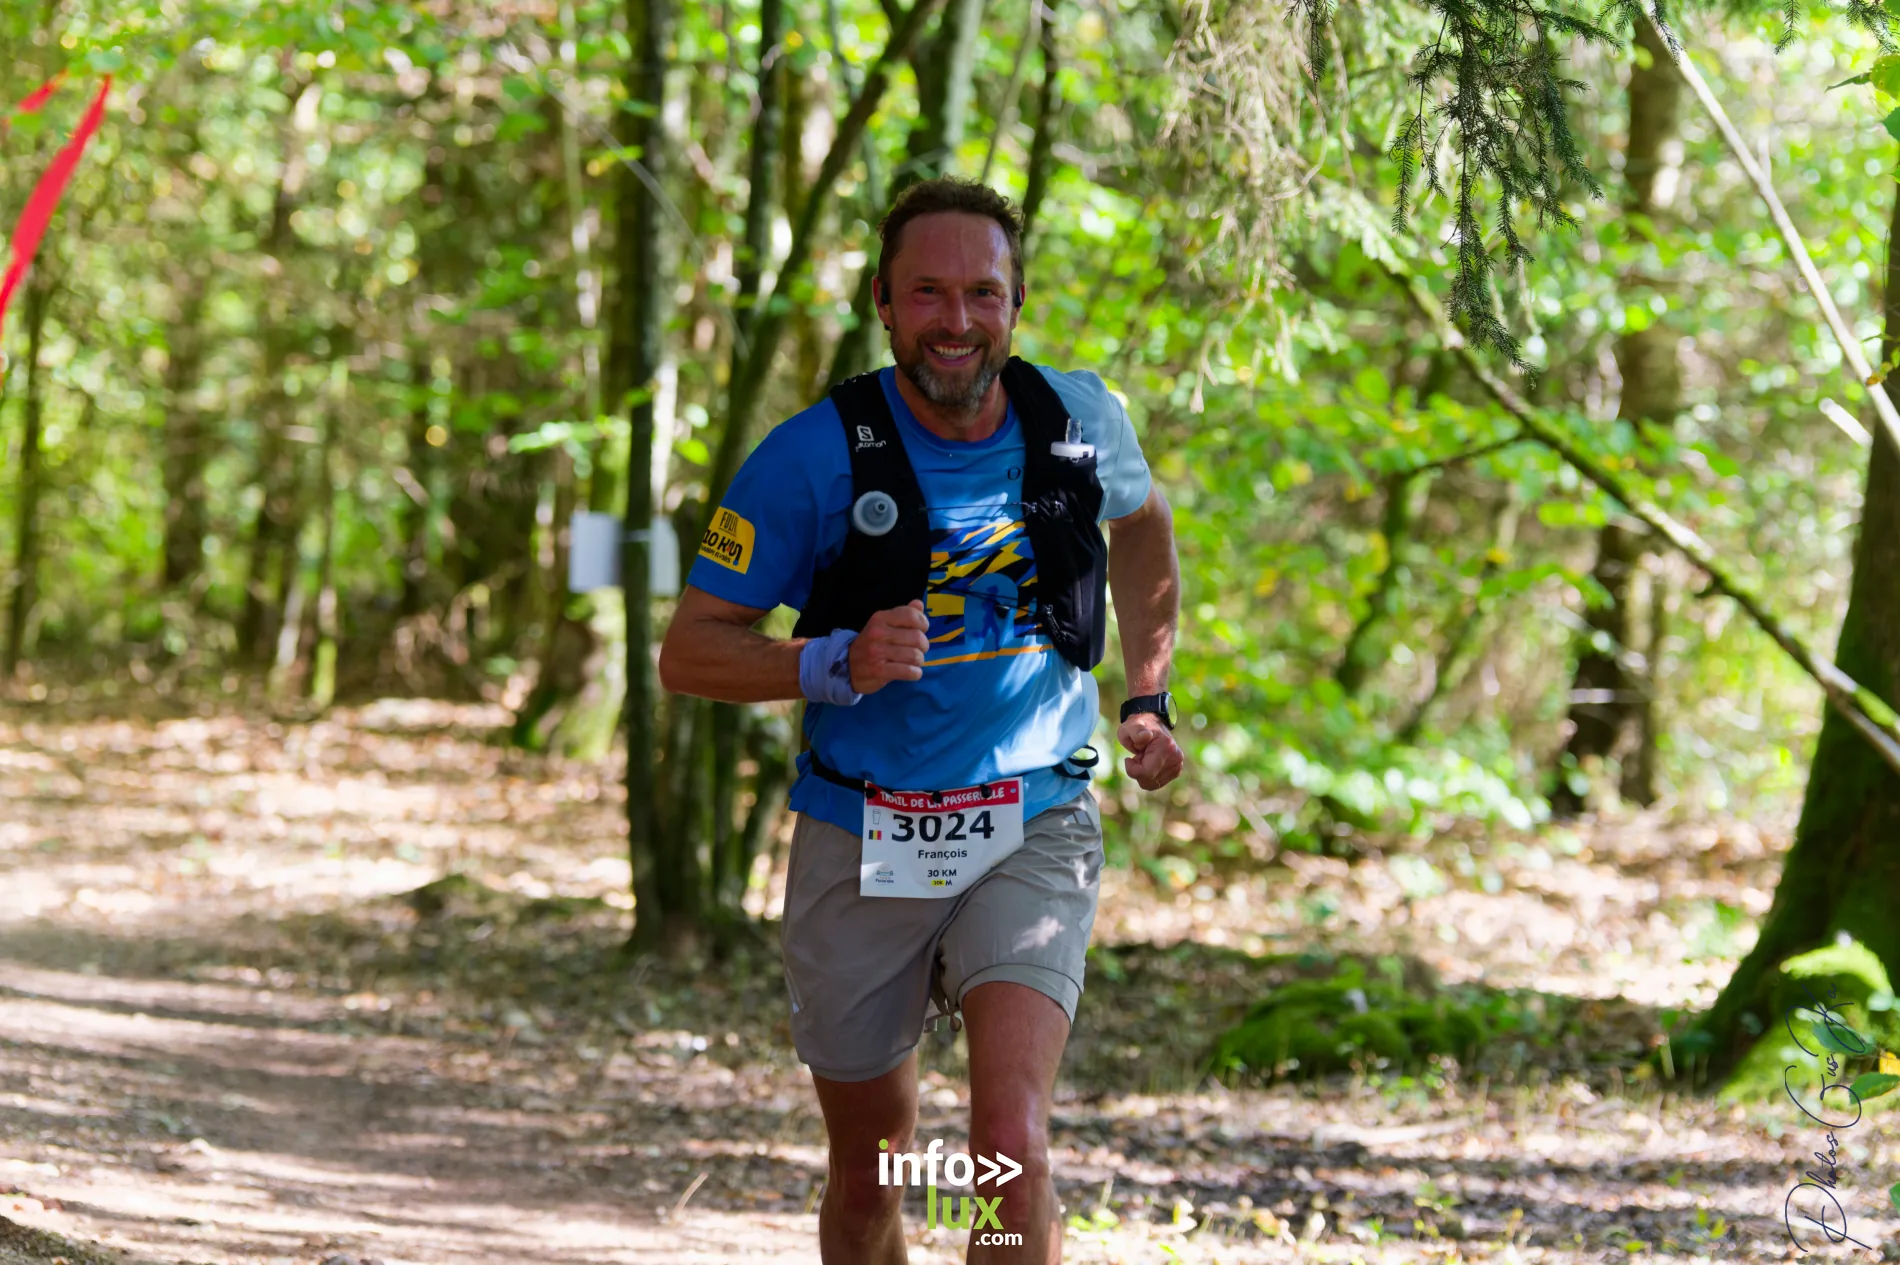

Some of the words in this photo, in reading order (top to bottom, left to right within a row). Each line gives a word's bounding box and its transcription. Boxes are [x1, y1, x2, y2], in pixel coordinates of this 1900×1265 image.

[880, 790, 907, 808] TRAIL
[910, 797, 924, 809] DE
[891, 810, 995, 843] 3024
[917, 848, 968, 861] François
[927, 869, 940, 878] 30
[942, 869, 957, 877] KM
